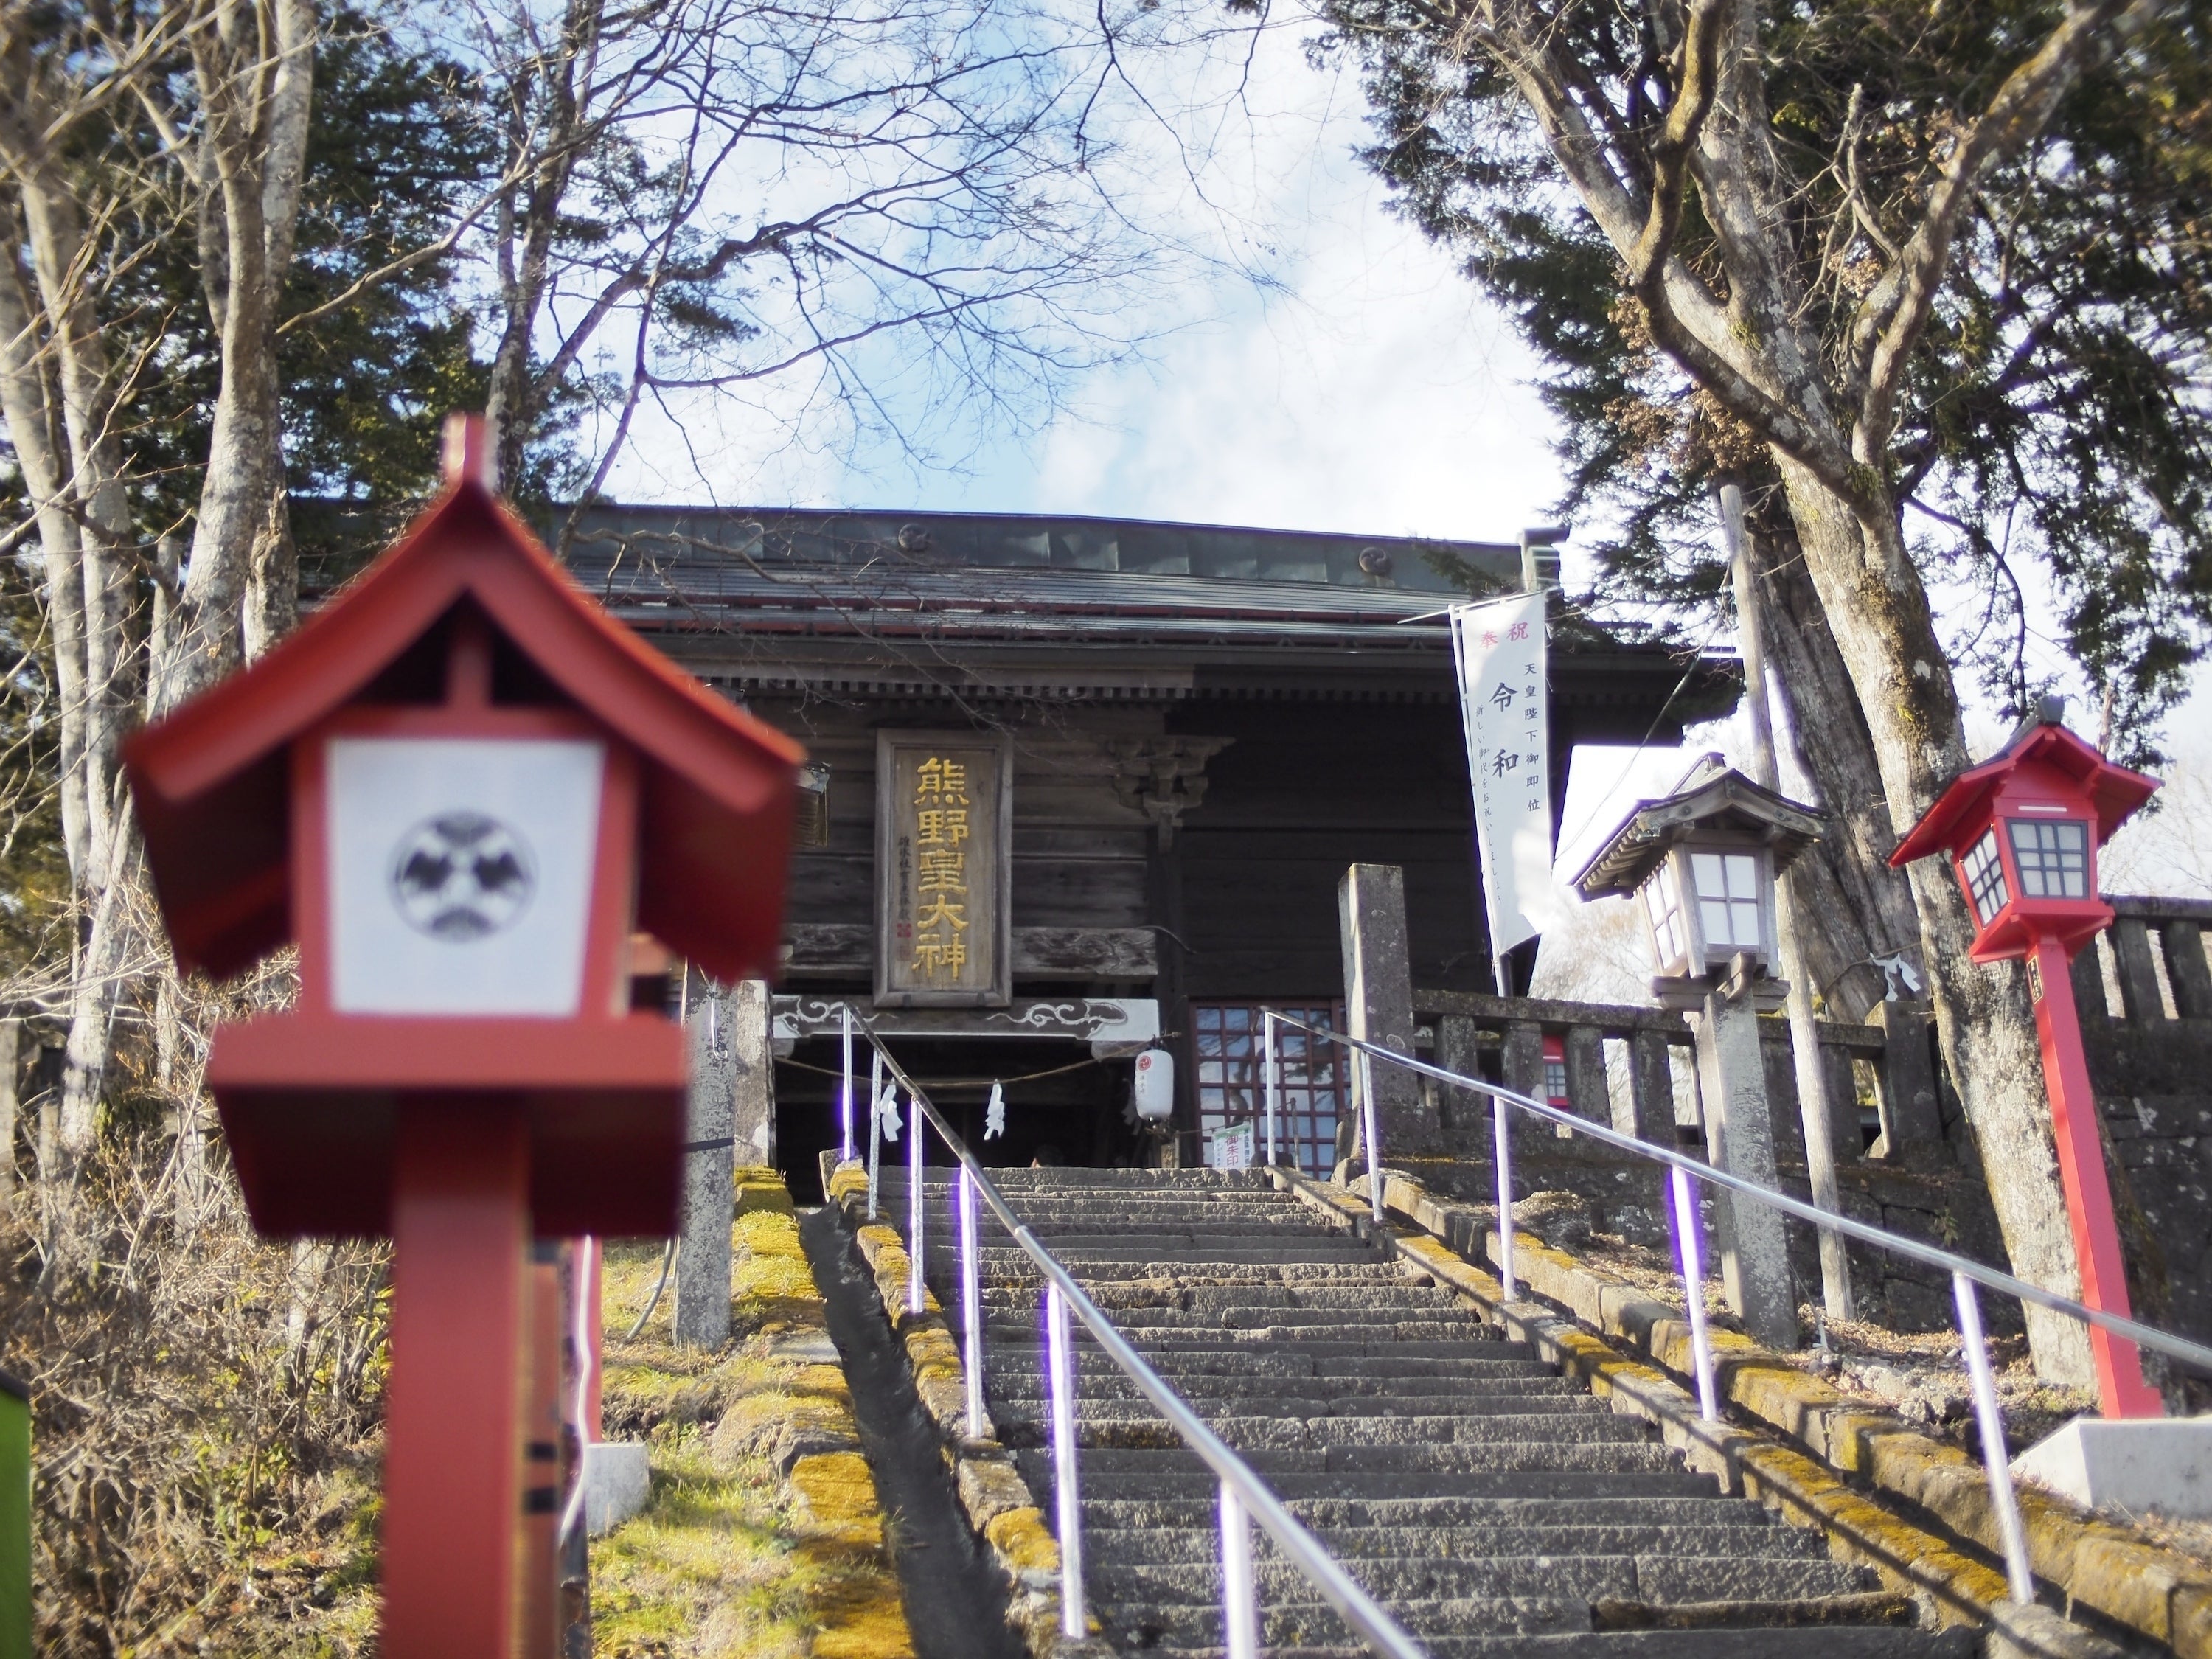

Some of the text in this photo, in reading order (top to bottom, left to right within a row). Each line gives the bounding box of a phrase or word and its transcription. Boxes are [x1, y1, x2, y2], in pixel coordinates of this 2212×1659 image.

[1478, 621, 1529, 650] 奉祝
[1488, 681, 1519, 779] 令和
[1523, 662, 1540, 813] 天皇陛下御即位
[911, 757, 970, 981] 熊野皇大神
[1225, 1134, 1239, 1166] 御朱印
